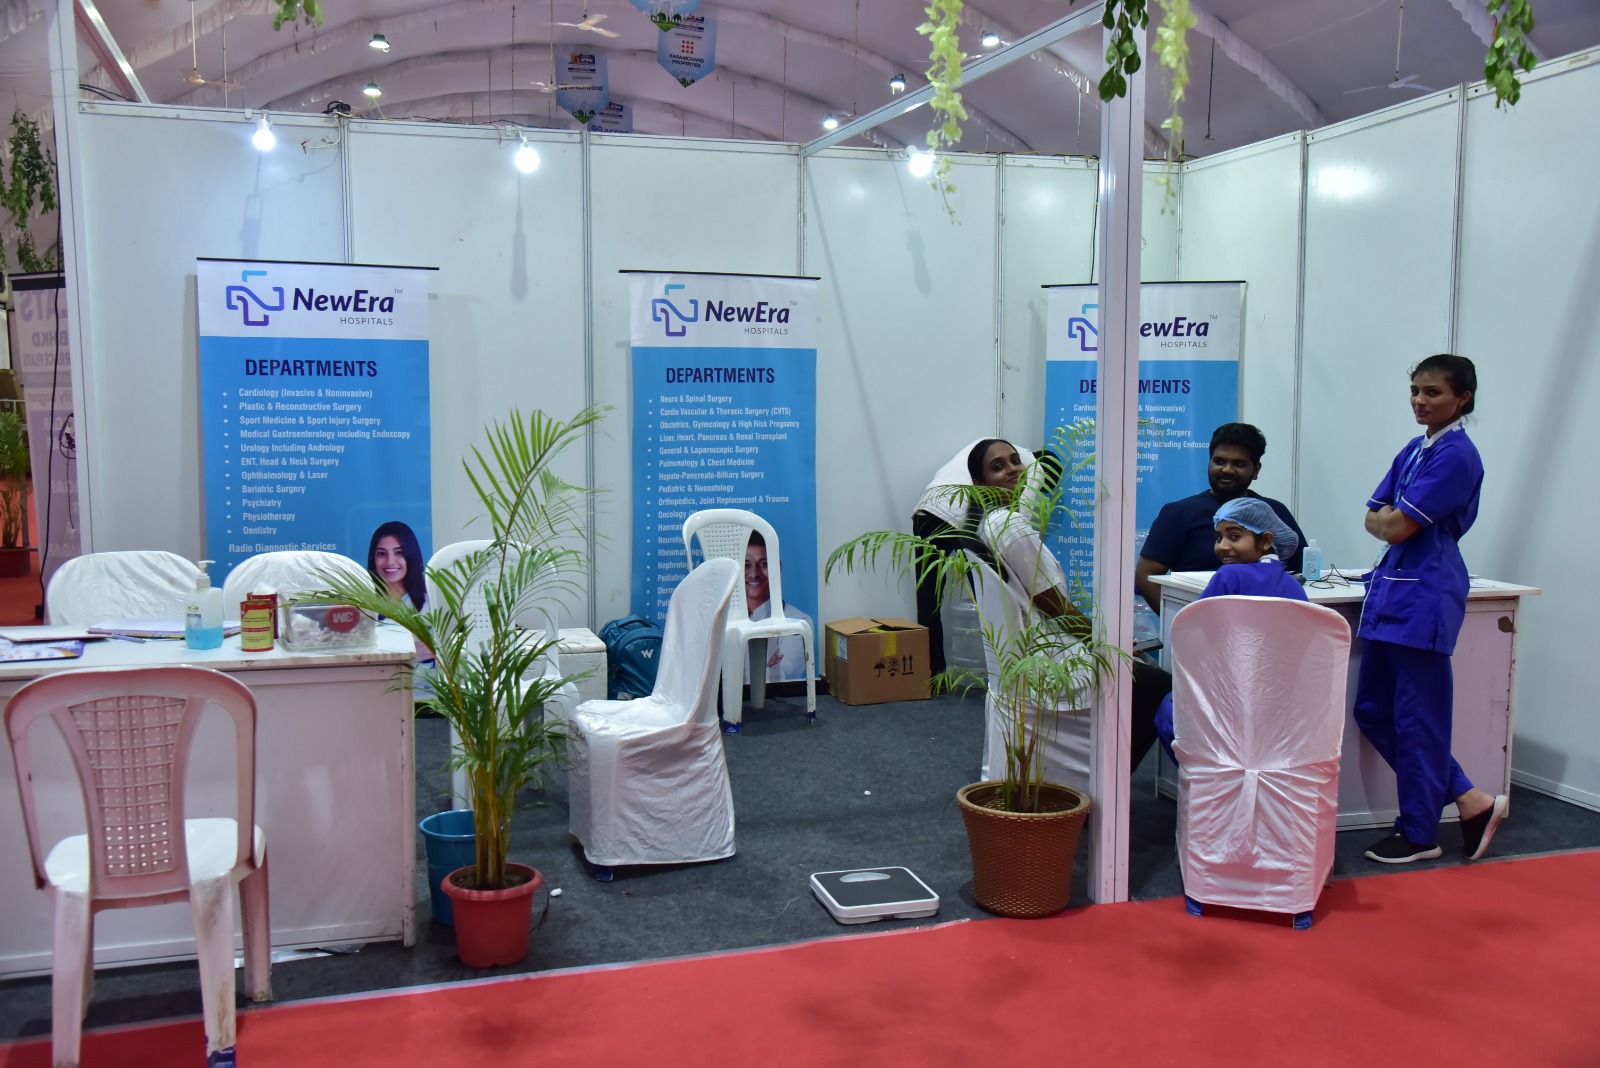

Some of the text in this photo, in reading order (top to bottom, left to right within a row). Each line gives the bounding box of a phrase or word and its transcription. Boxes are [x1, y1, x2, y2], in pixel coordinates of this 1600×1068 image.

[293, 288, 394, 313] NewEra
[705, 300, 789, 323] NewEra
[1140, 316, 1209, 337] ewEra
[245, 359, 377, 377] DEPARTMENTS
[666, 368, 775, 383] DEPARTMENTS
[239, 388, 279, 398] Cardiology
[281, 389, 314, 398] (Invasive
[326, 389, 372, 398] Noninvasive)
[686, 395, 705, 404] Spinal
[708, 395, 732, 404] Surgery
[333, 403, 361, 412] Surgery
[240, 417, 260, 426] Sport
[307, 417, 326, 426] Sport
[329, 417, 350, 426] Injury
[352, 417, 380, 426] Surgery
[693, 421, 729, 429] Gynecology
[1151, 417, 1175, 425] Surgery
[272, 430, 335, 440] Gastroenterology
[373, 430, 410, 439] Endoscopy
[241, 444, 344, 453] Urology Including Andrology
[241, 458, 257, 466] ENT,
[311, 458, 339, 466] Surgery
[242, 472, 297, 481] Ophthalmology
[276, 485, 305, 494] Surgery
[243, 499, 281, 508] Psychiatry
[243, 513, 295, 522] Physiotherapy
[658, 511, 686, 519] Oncology
[243, 527, 276, 536] Dentistry
[229, 543, 336, 553] Radio Diagnostic Services
